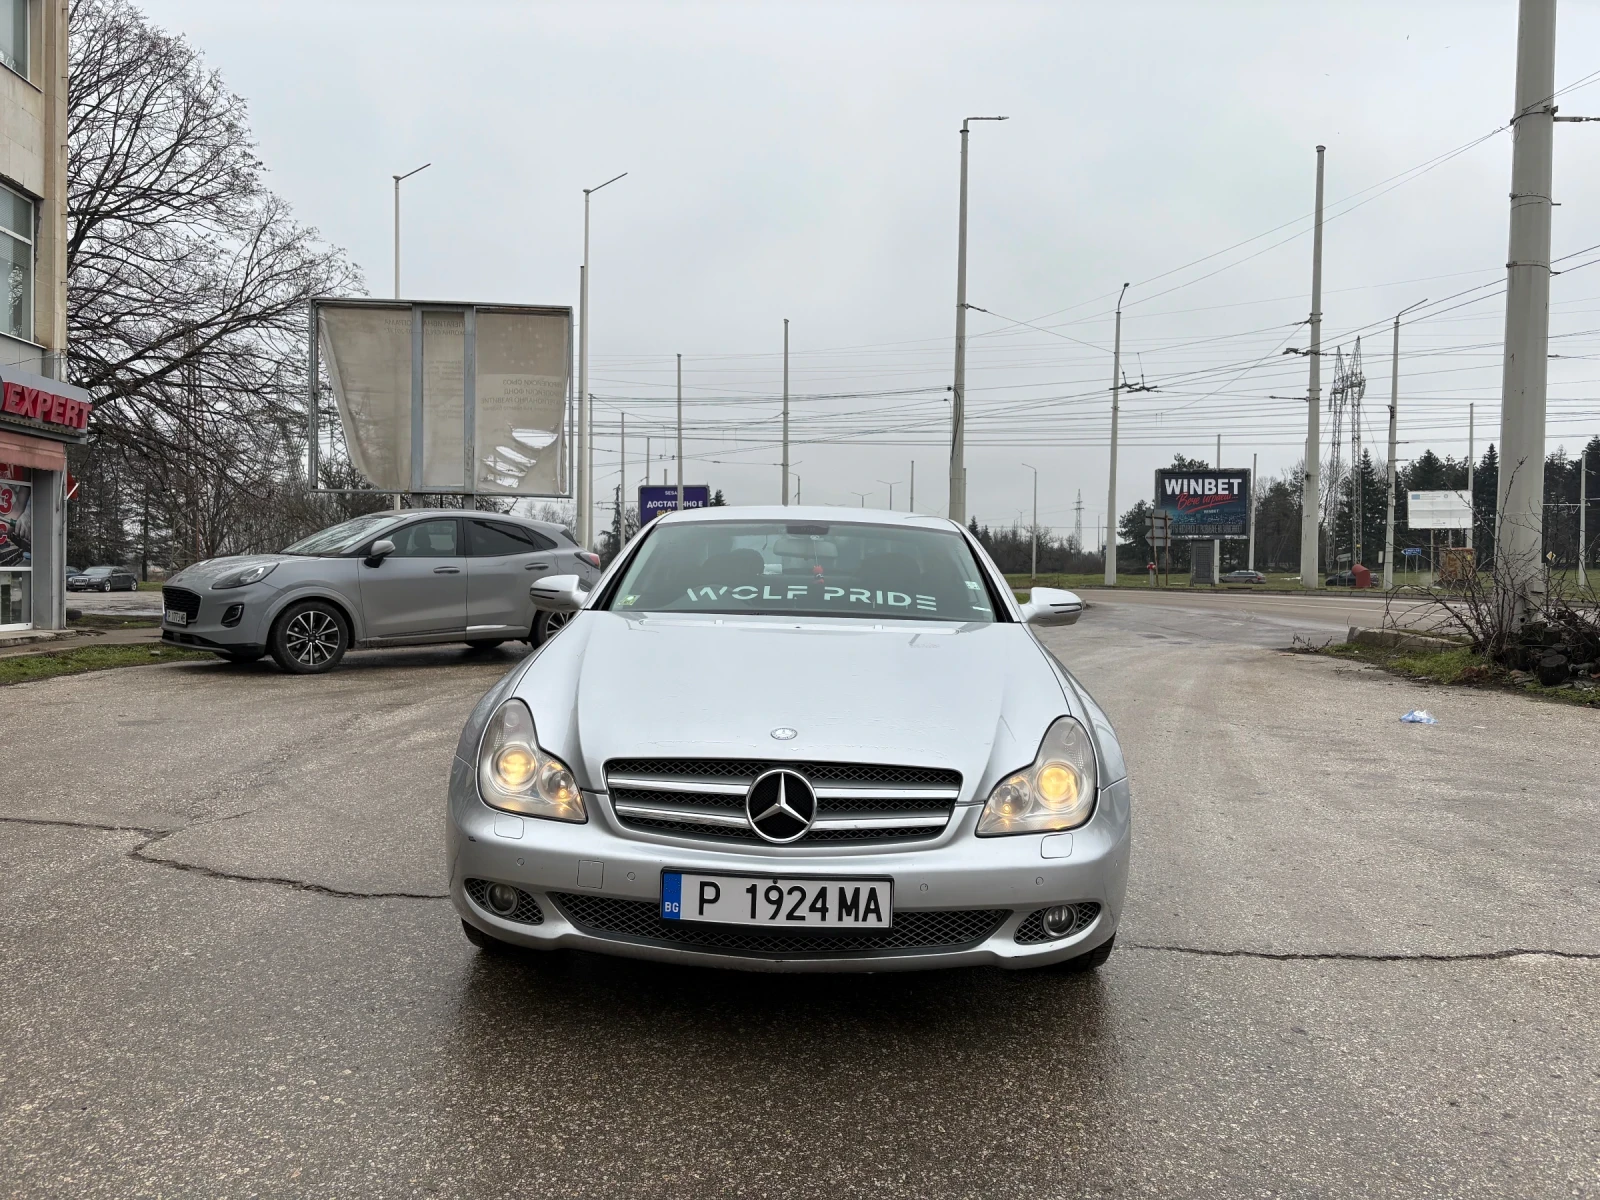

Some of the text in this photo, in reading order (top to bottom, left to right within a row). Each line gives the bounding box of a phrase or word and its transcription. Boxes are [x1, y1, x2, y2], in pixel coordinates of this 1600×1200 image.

[4, 382, 92, 429] EXPERT
[1164, 478, 1242, 495] WINBET
[686, 585, 937, 611] WOLF PRIDE
[664, 901, 679, 913] BG
[699, 881, 882, 922] P 1924 MA
